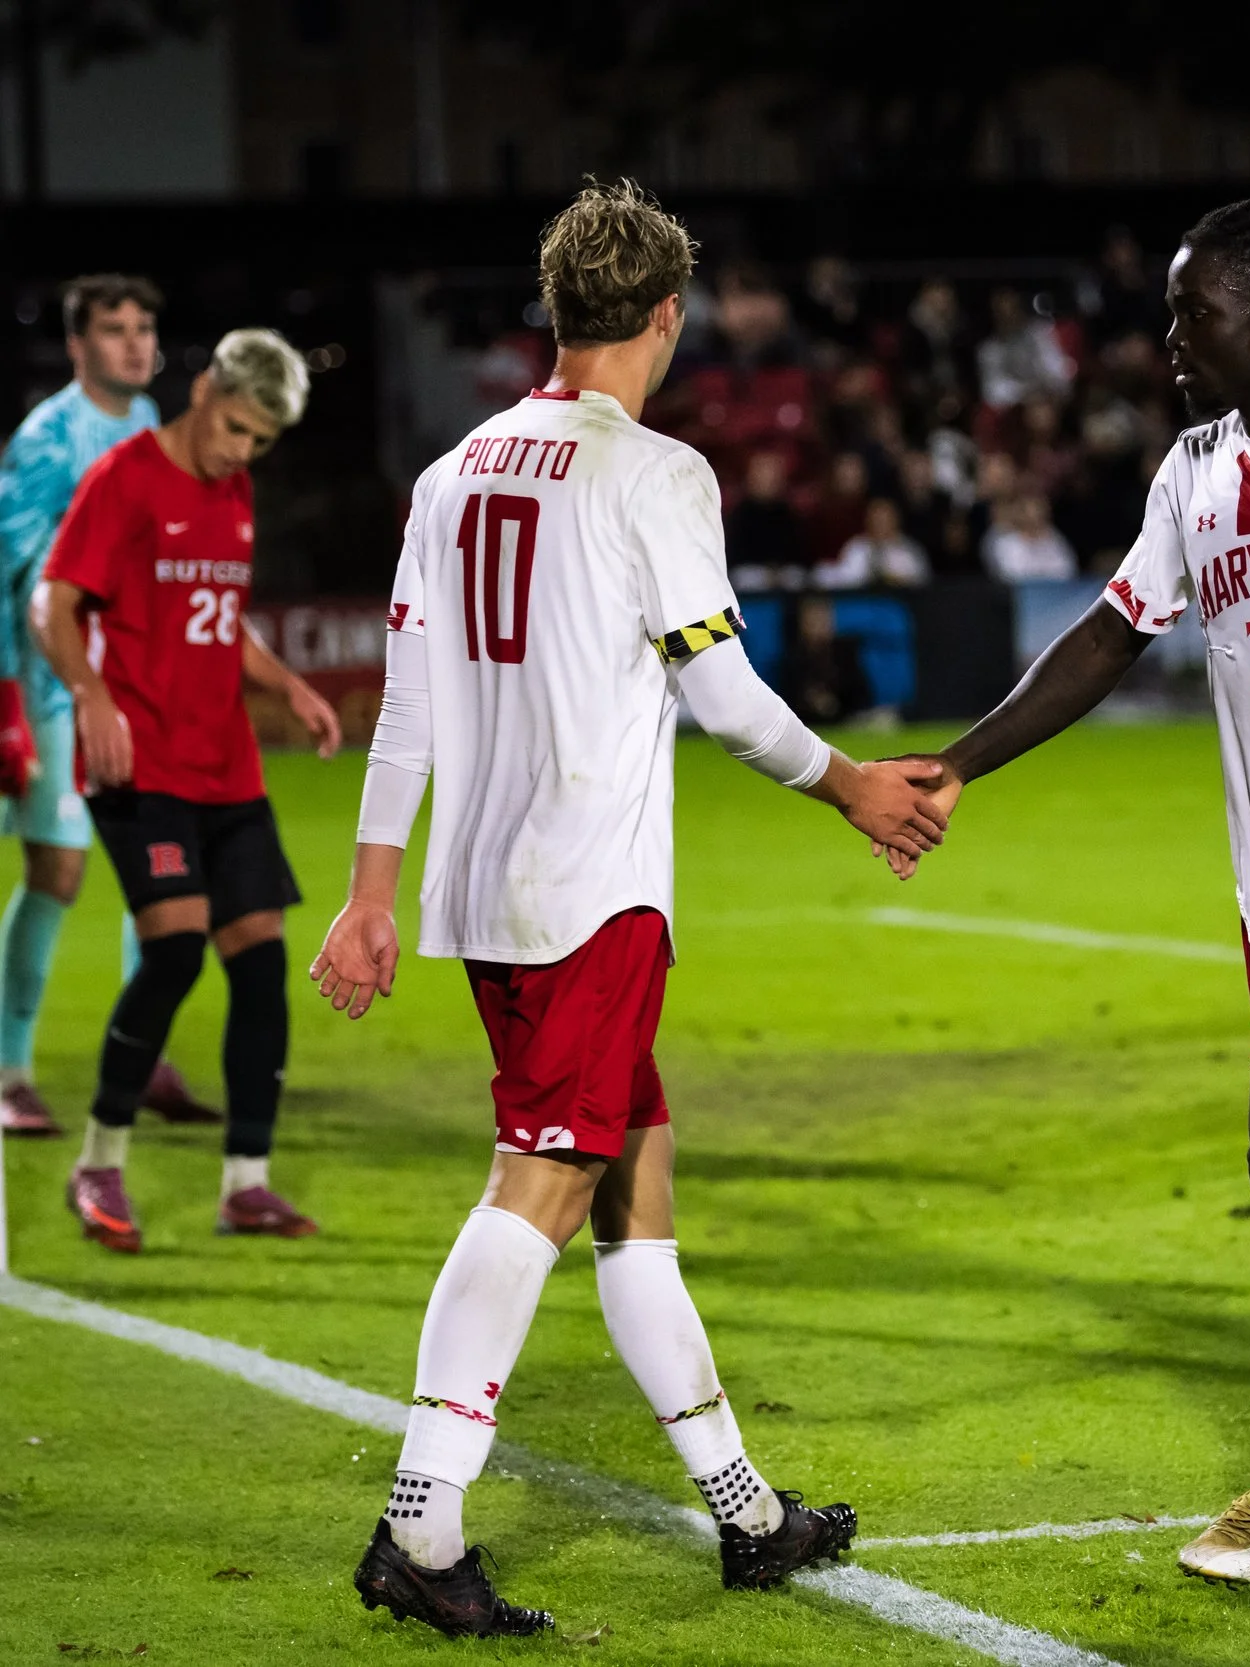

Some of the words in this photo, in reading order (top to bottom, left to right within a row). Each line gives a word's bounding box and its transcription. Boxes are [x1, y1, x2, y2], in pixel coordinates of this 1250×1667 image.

[459, 437, 578, 481] PICOTTO
[457, 494, 540, 664] 10
[147, 842, 190, 877] R
